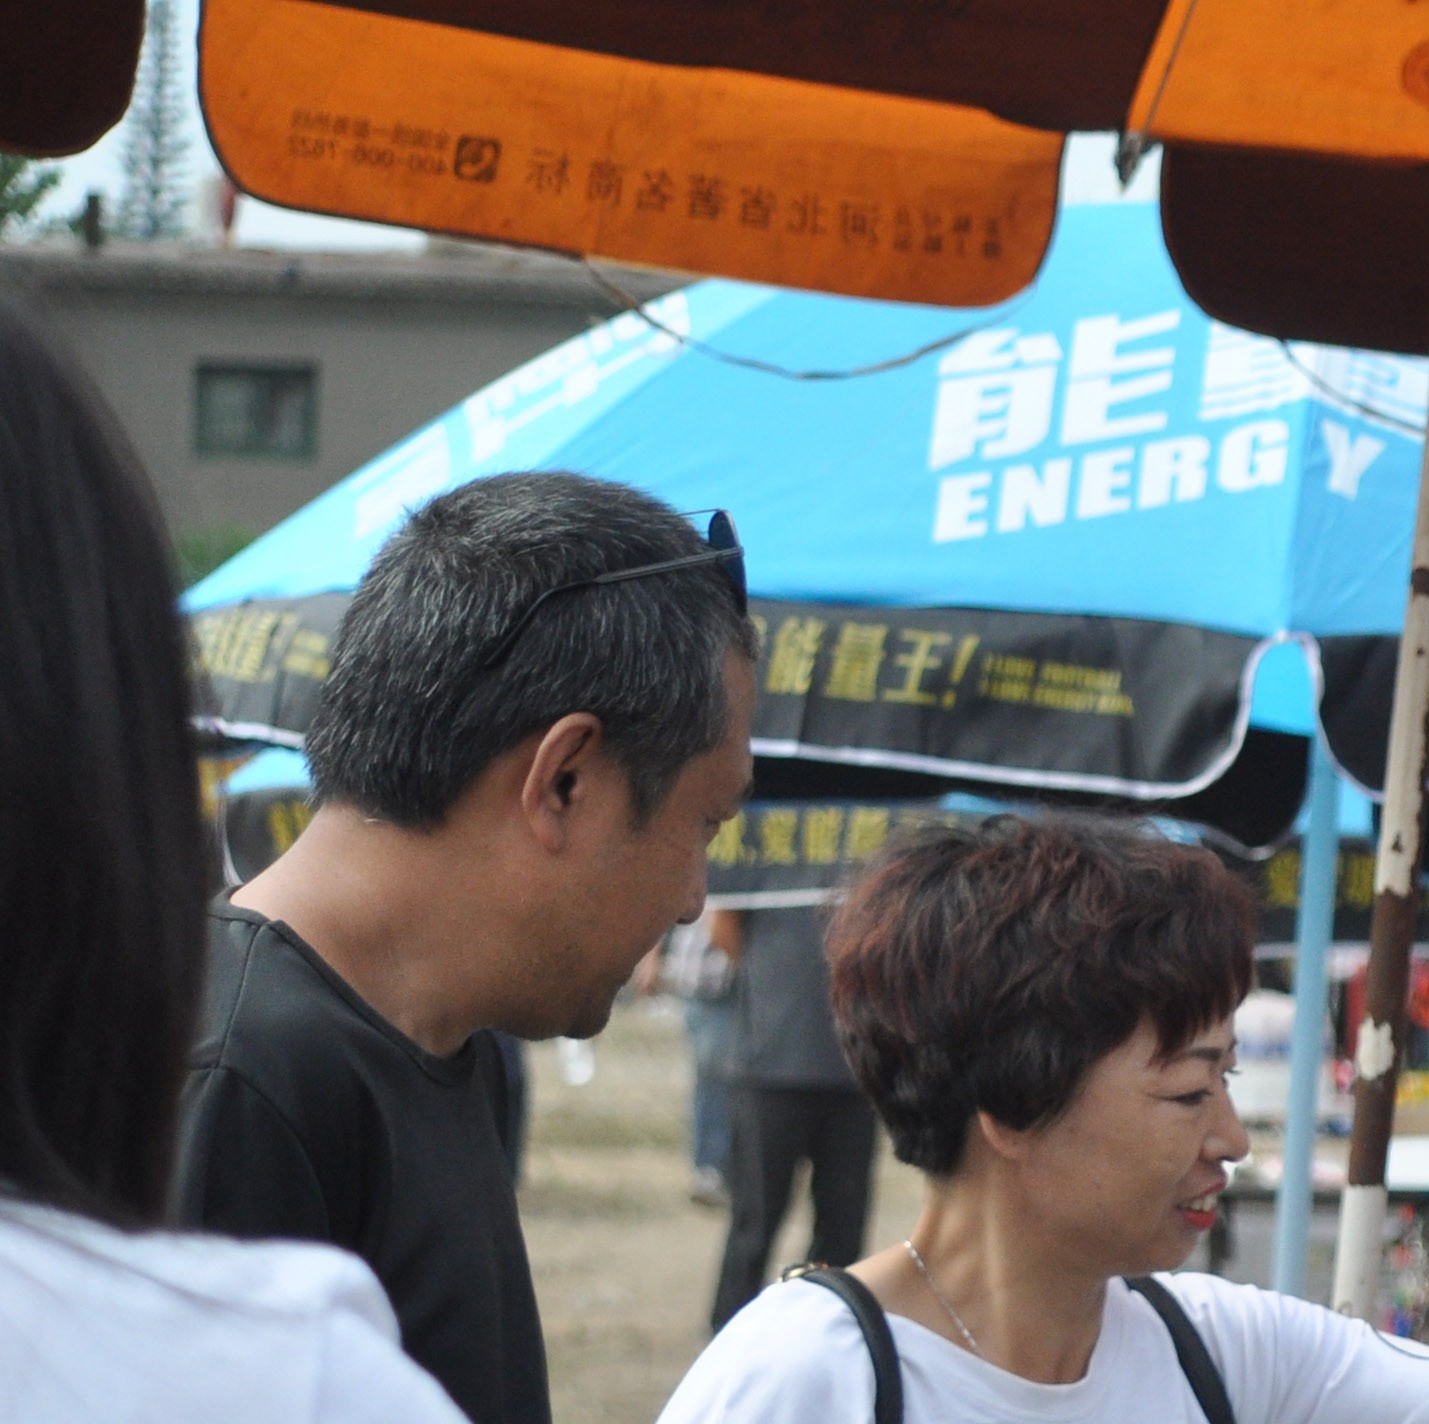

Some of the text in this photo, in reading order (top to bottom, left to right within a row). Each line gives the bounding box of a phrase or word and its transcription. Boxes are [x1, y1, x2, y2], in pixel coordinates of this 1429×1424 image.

[932, 420, 1387, 544] ENERGY
[755, 613, 981, 710] 能量王!
